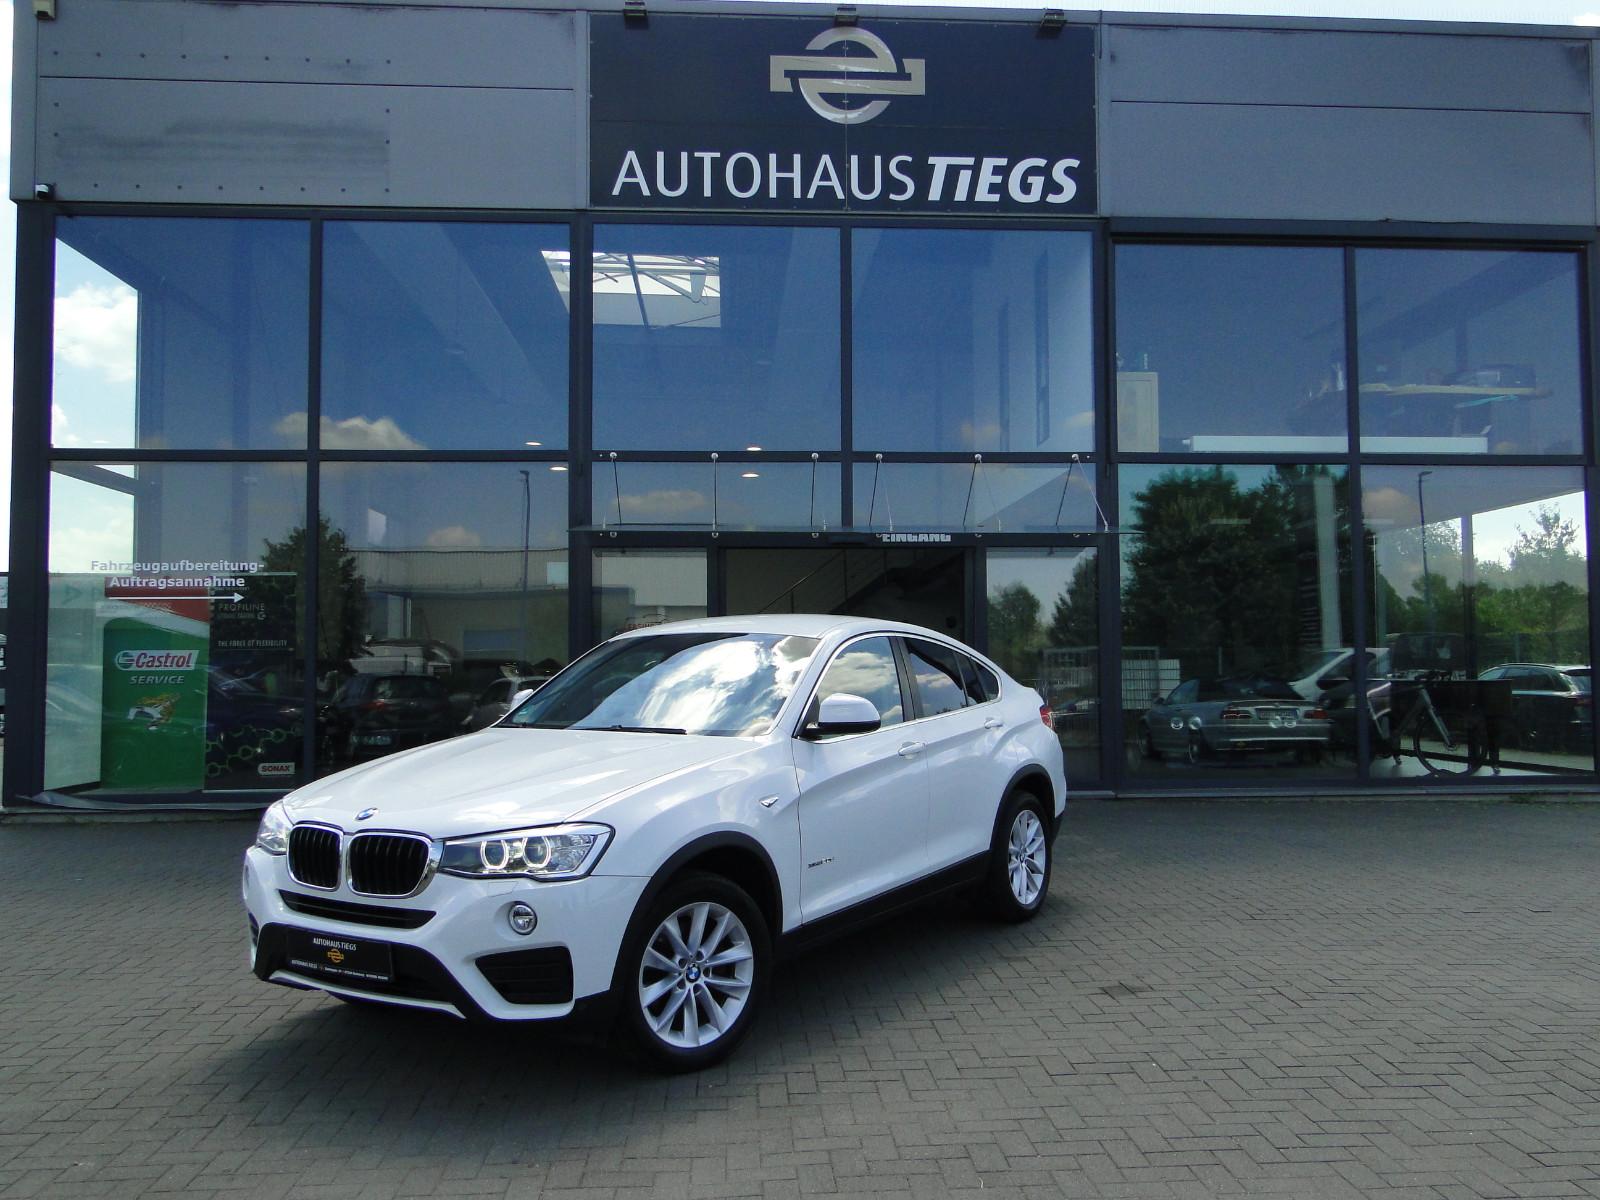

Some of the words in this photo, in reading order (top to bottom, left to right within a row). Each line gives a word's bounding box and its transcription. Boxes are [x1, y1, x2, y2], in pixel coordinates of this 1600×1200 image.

[611, 150, 915, 201] AUTOHAUS
[882, 533, 952, 543] EINGANG
[109, 576, 245, 590] Auftragsannahme
[218, 603, 265, 611] PROFILINE
[135, 652, 193, 669] Castrol
[129, 675, 185, 685] SERVICE
[313, 937, 341, 949] AUTOHAUS
